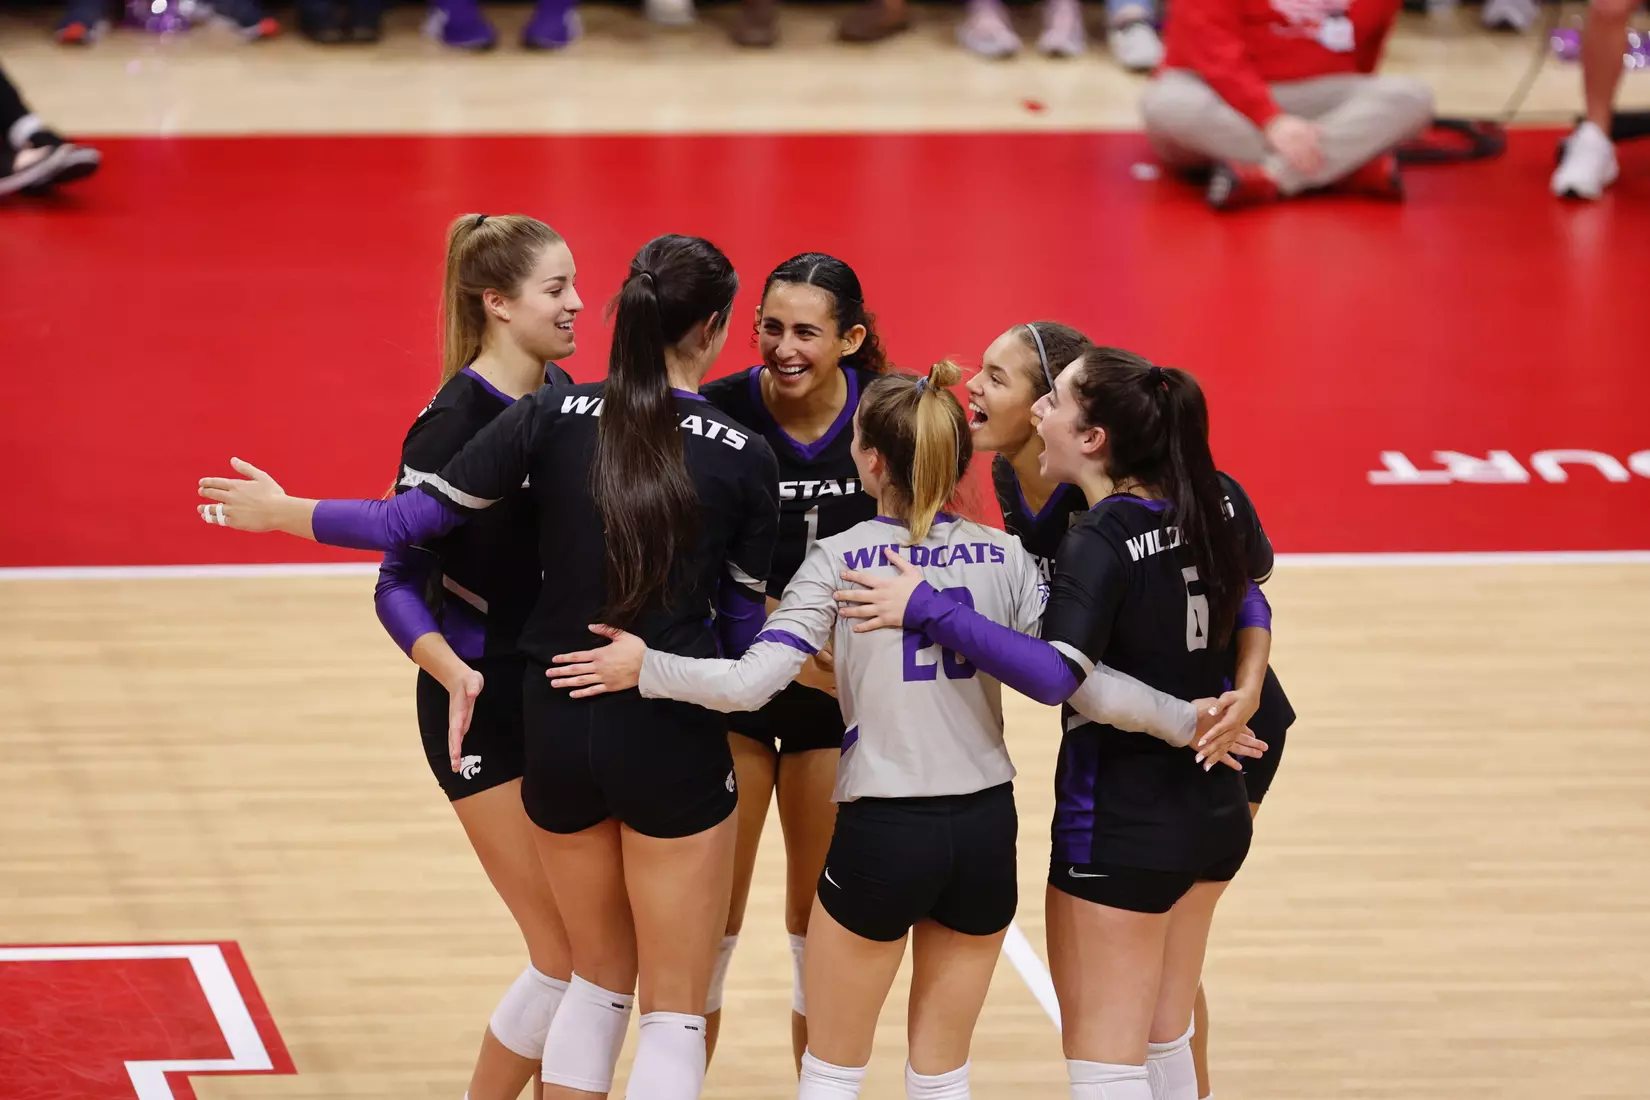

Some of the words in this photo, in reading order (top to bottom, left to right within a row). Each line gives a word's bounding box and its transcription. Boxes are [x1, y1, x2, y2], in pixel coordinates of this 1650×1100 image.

[561, 396, 748, 451] WIATS
[778, 477, 864, 500] STAT
[1366, 449, 1650, 485] URT
[1181, 565, 1209, 652] 6
